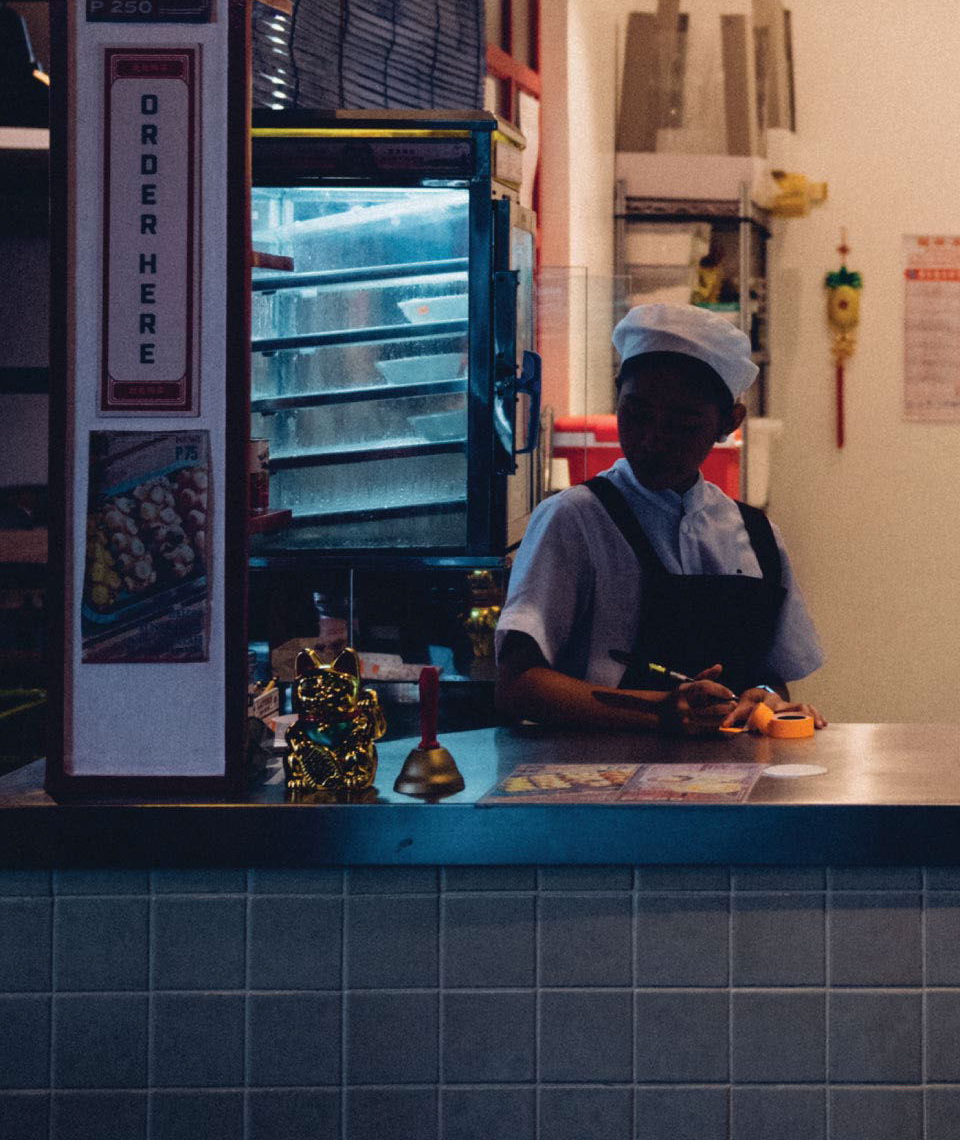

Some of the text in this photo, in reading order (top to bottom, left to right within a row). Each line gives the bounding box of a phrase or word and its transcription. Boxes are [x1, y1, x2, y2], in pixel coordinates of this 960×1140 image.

[110, 0, 153, 14] 250
[140, 93, 158, 235] ORDER
[139, 252, 157, 365] HERE
